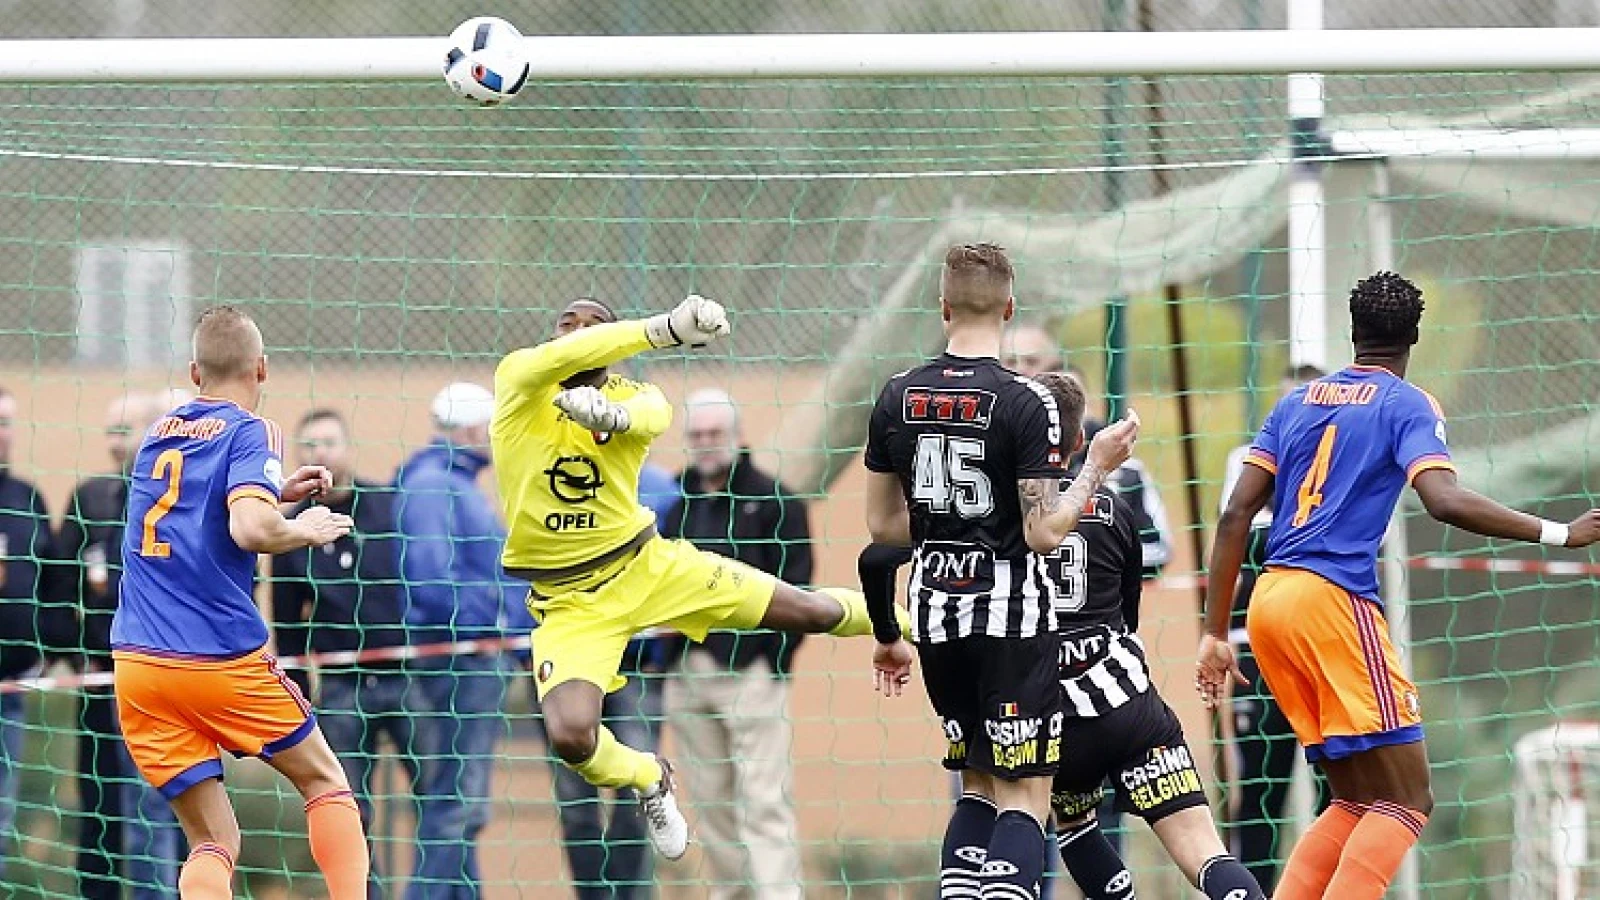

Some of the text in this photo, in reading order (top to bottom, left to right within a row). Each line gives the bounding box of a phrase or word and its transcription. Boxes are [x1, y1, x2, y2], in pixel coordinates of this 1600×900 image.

[906, 392, 981, 422] 777
[912, 433, 995, 519] 45
[1292, 424, 1337, 528] 4
[140, 449, 184, 557] 2
[545, 512, 598, 531] OPEL
[1121, 745, 1193, 790] CASINO
[1130, 769, 1201, 810] BELGIUM
